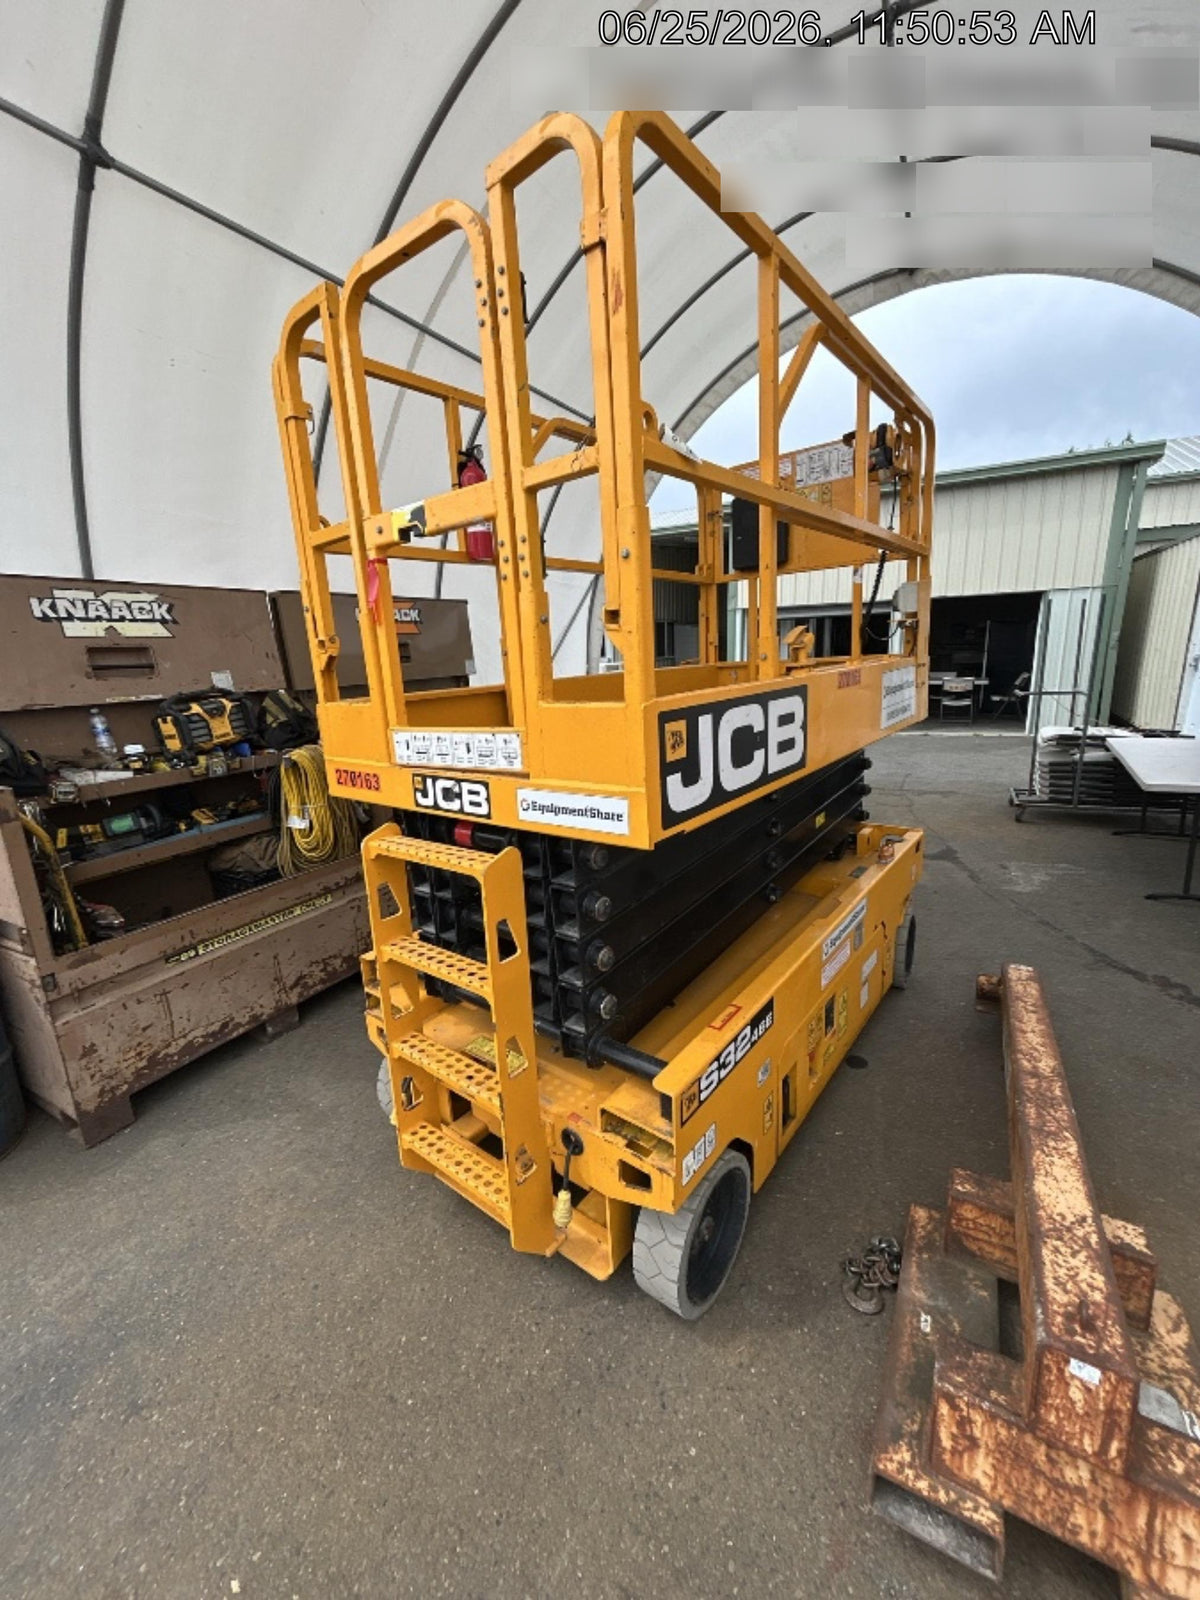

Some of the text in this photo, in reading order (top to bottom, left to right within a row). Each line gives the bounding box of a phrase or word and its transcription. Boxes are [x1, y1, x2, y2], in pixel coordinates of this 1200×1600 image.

[29, 597, 174, 621] KNAACK
[666, 695, 805, 813] JCB
[335, 769, 381, 791] 270163
[415, 777, 490, 816] JCB
[530, 800, 624, 822] EquipmentShare
